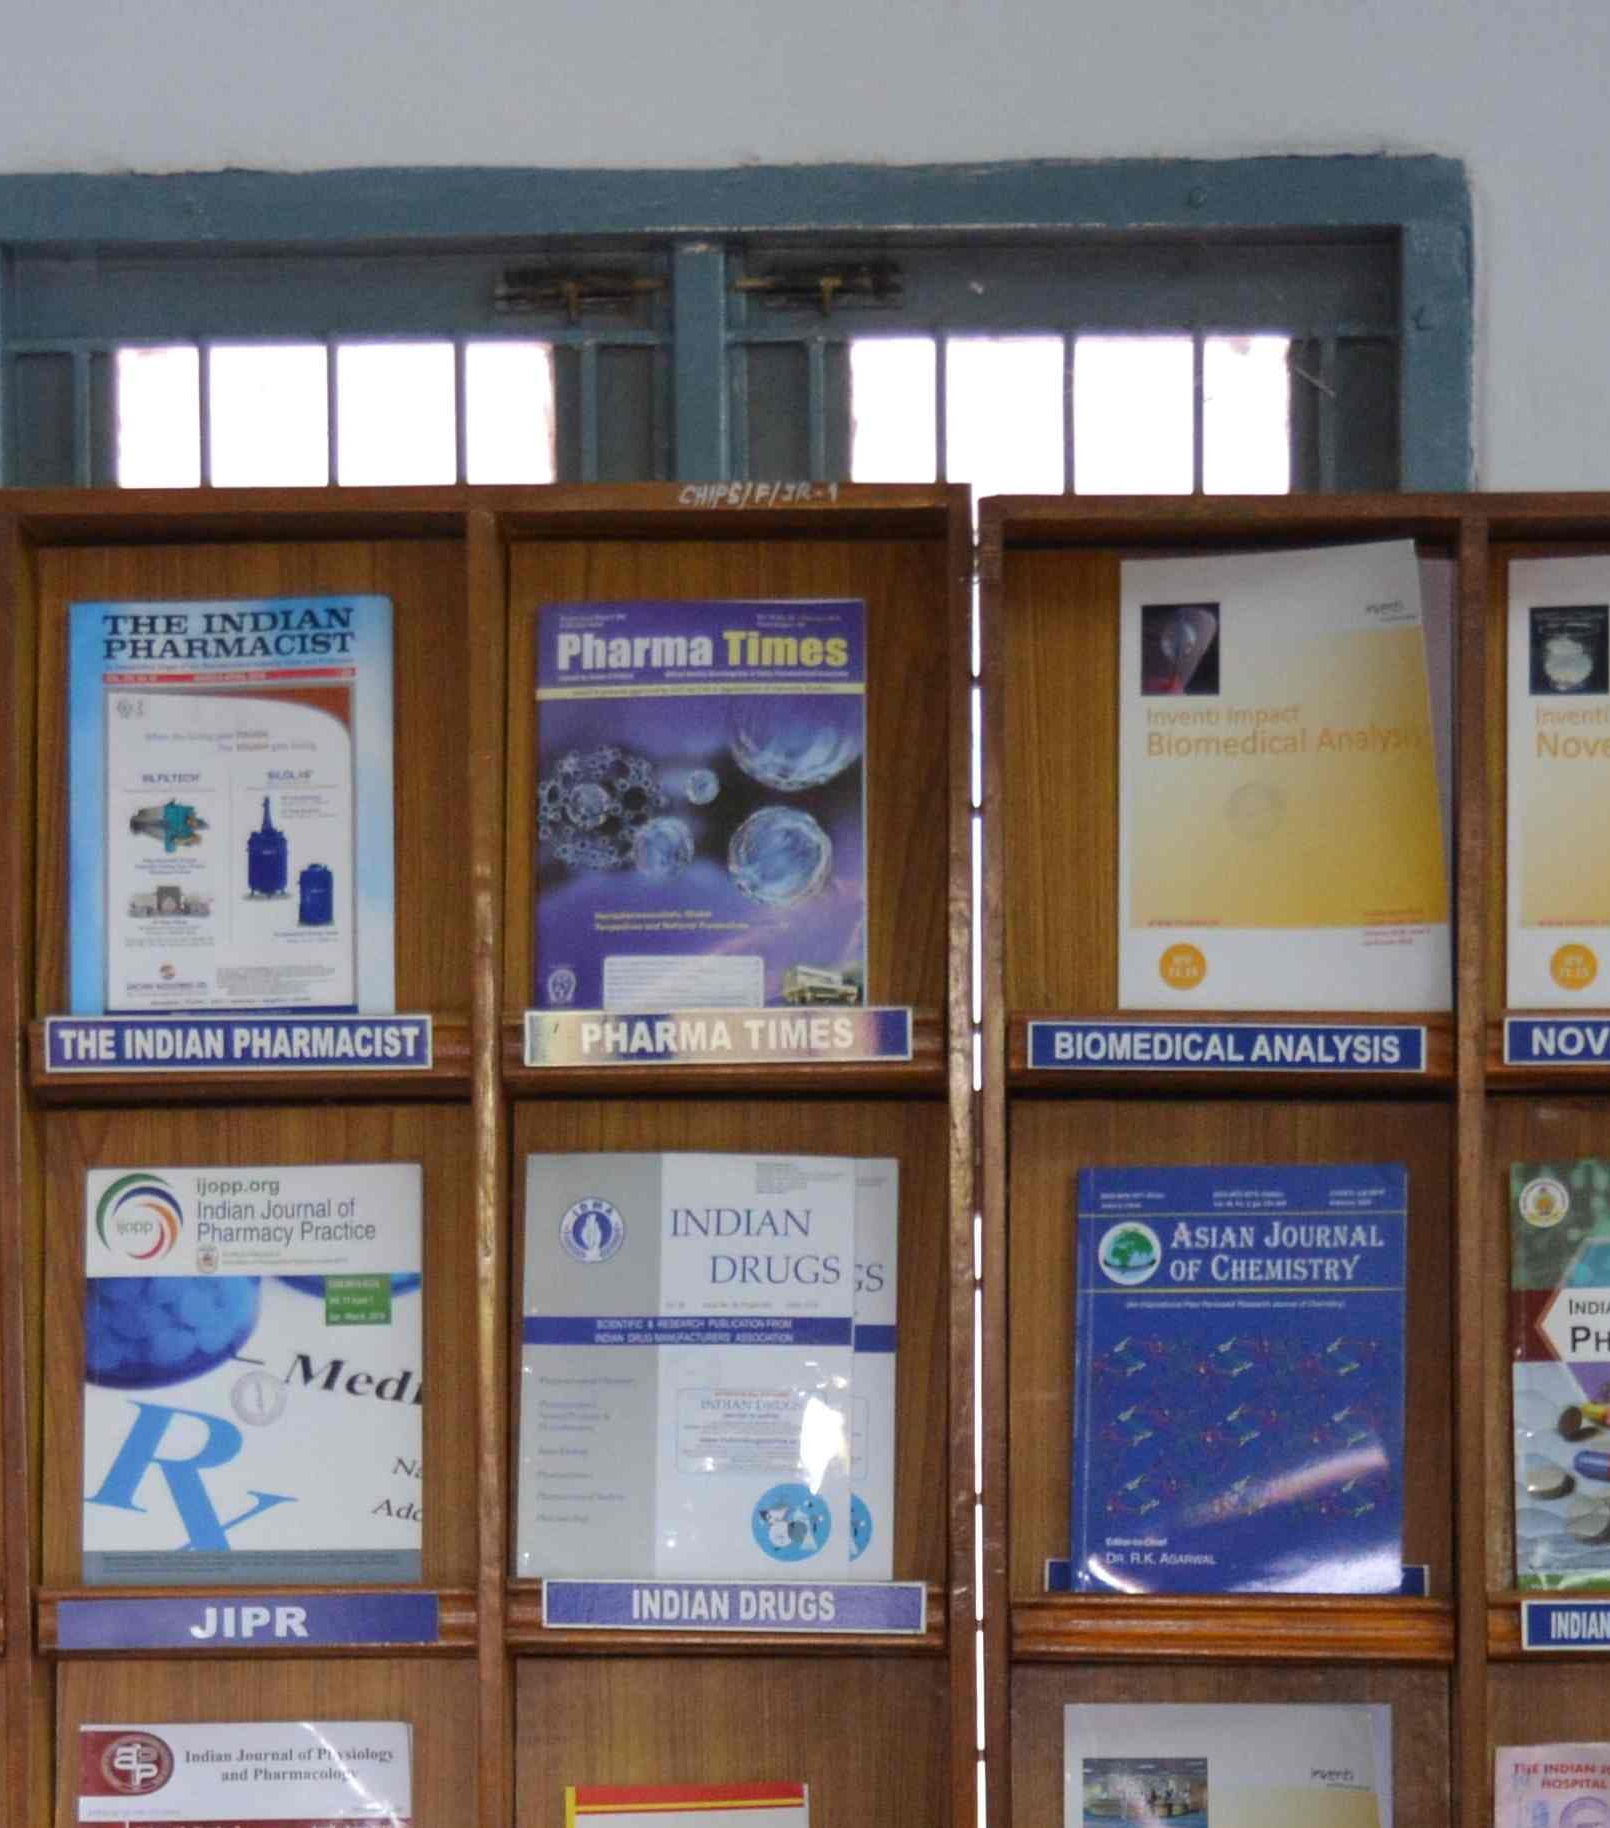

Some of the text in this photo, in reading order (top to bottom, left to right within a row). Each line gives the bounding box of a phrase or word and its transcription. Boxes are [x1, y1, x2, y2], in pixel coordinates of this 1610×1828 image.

[103, 607, 354, 637] THE INDIAN
[103, 631, 356, 660] PHARMACIST
[557, 630, 849, 671] Pharma Times
[59, 1025, 420, 1060] THE INDIAN PHARMACIST
[580, 1016, 855, 1054] PHARMA TIMES
[1053, 1030, 1401, 1064] BIOMEDICAL ANALYSIS
[197, 1197, 356, 1220] Indian Journal of
[670, 1208, 813, 1239] INDIAN
[197, 1220, 376, 1246] Pharmacy Practice
[710, 1255, 842, 1285] DRUGS
[632, 1588, 836, 1622] INDIAN DRUGS
[190, 1605, 309, 1639] JIPR
